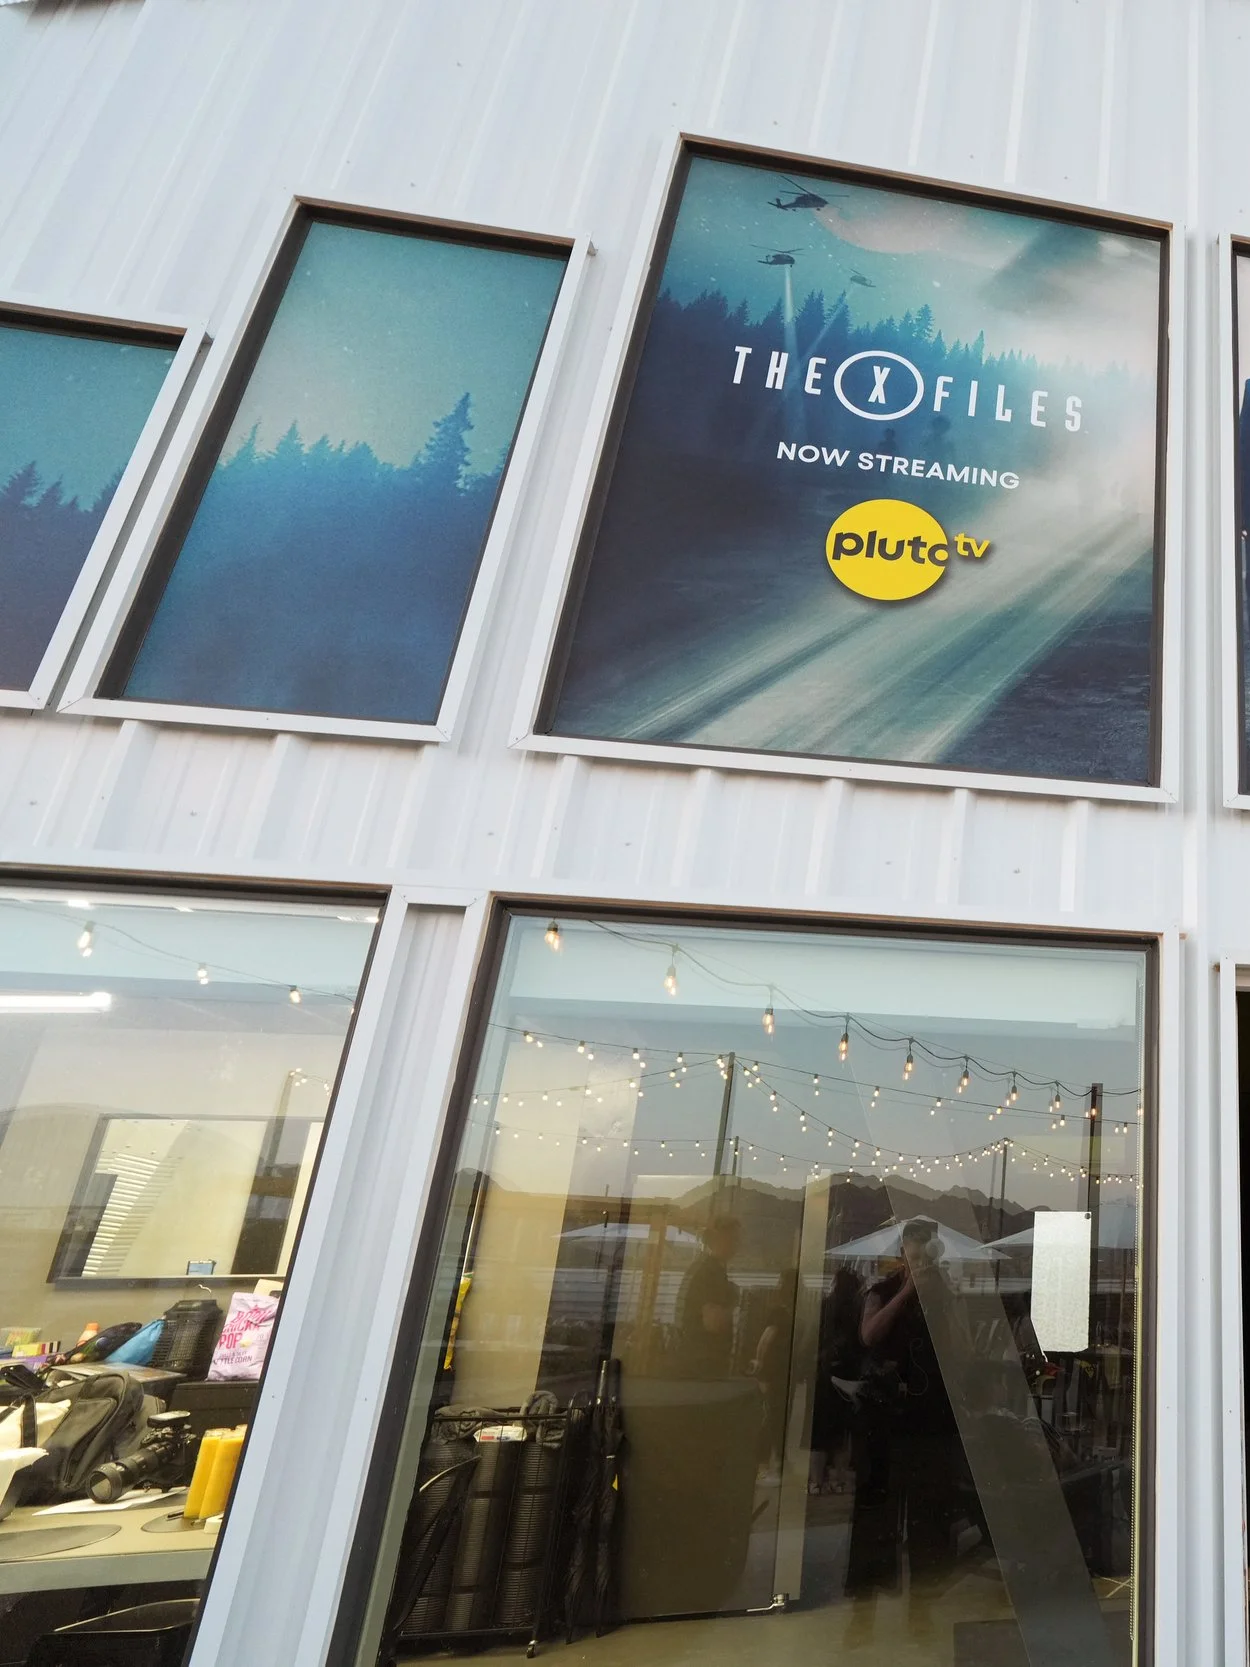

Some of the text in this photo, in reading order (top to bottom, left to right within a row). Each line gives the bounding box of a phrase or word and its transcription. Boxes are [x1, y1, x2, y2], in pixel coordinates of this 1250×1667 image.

[733, 346, 827, 395] THE
[933, 376, 1083, 432] FILES
[776, 441, 1020, 489] NOW STREAMING
[832, 529, 990, 568] pluto tv
[219, 1333, 243, 1349] POP
